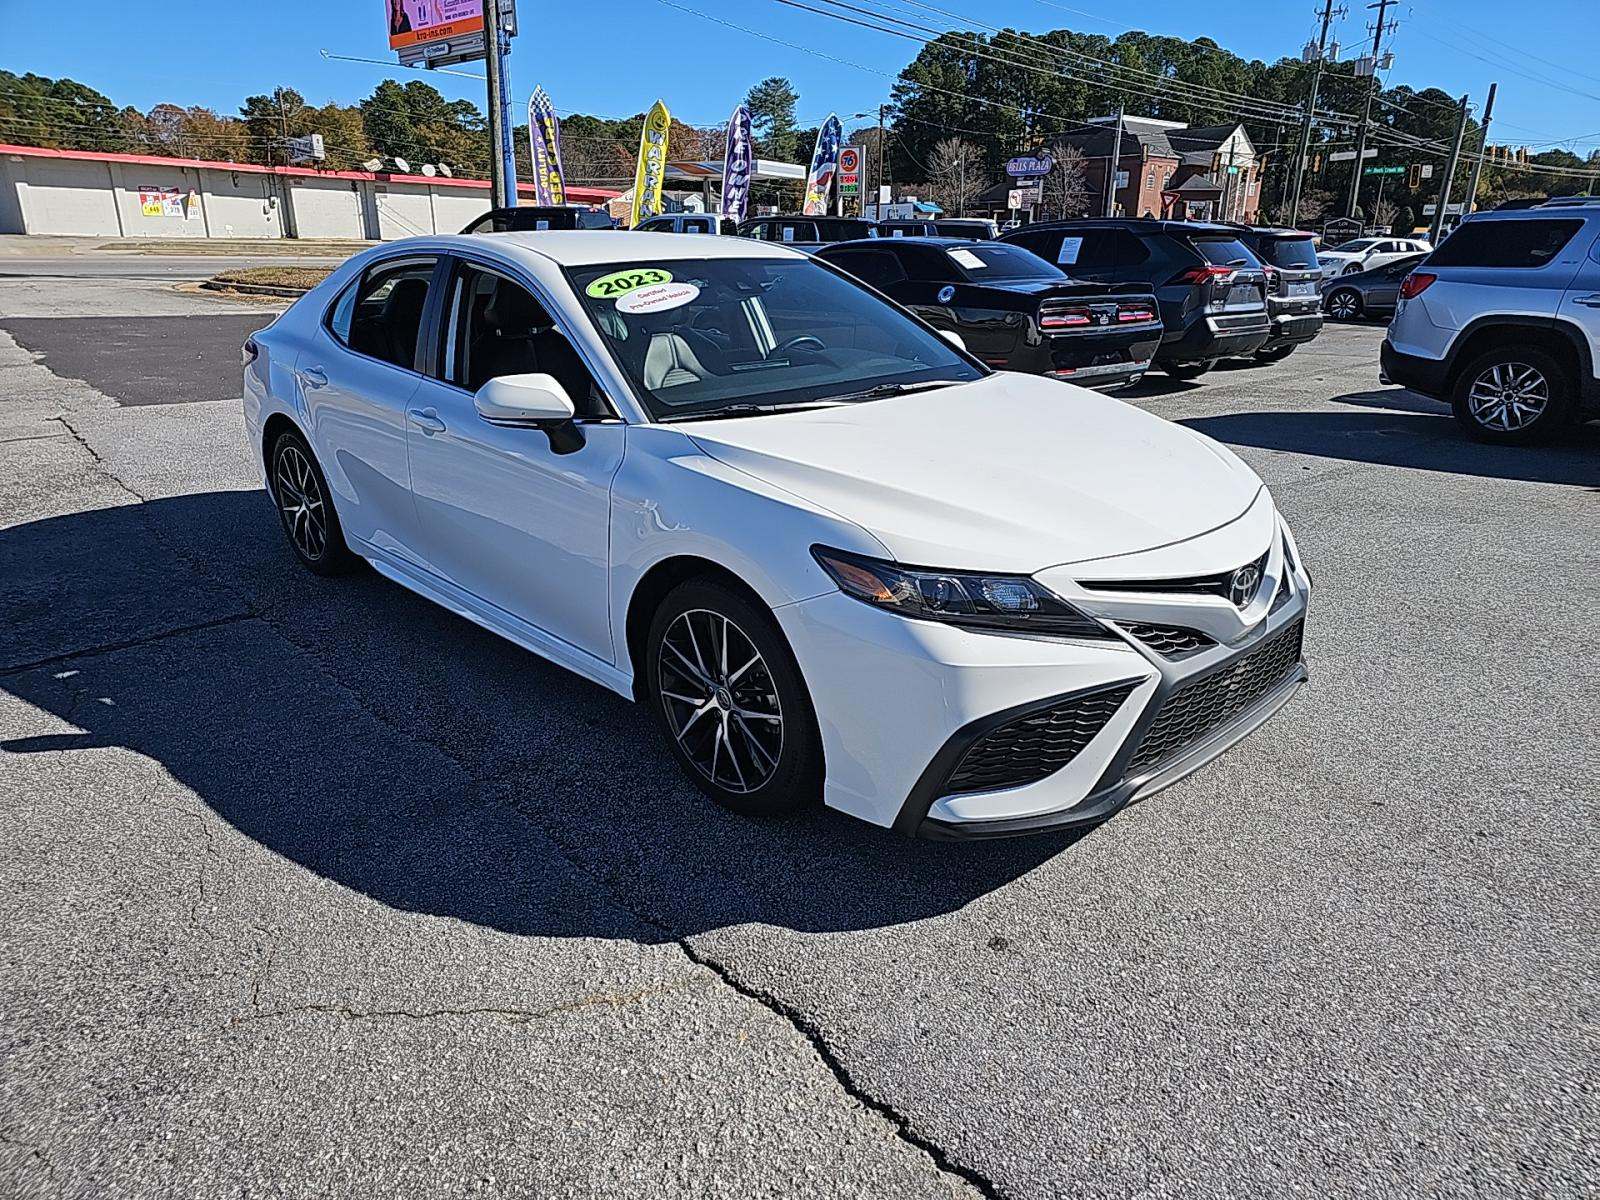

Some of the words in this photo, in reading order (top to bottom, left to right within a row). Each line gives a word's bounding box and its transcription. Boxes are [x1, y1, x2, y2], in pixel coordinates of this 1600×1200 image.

[537, 147, 549, 188] QUALITY
[843, 156, 854, 166] 76
[1008, 161, 1026, 172] BELLS
[1028, 160, 1049, 171] PLAZA
[598, 271, 664, 296] 2023
